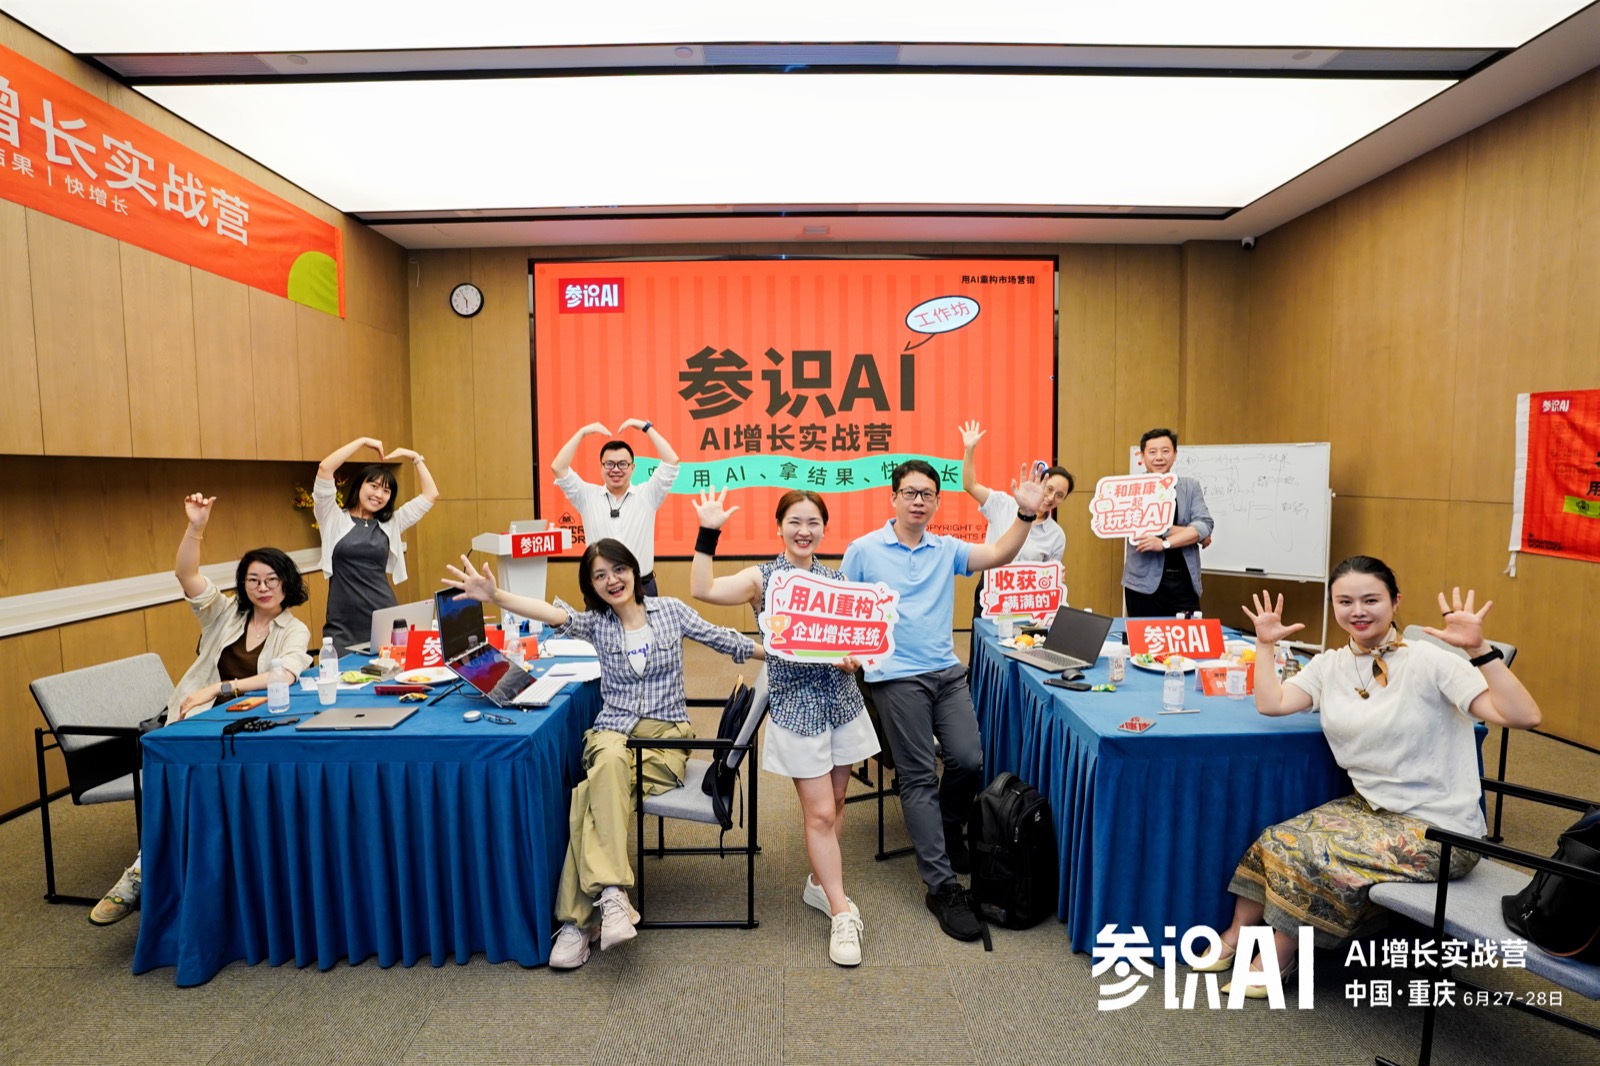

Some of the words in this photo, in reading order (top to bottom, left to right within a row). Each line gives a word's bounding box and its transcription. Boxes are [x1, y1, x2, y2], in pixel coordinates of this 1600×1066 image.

[0, 75, 249, 246] 长实战营
[0, 148, 35, 178] 果
[64, 174, 128, 216] 快增长
[961, 275, 1035, 285] 用AI重构市场营销
[565, 284, 618, 308] 参识AI
[914, 301, 970, 328] 工作坊
[677, 345, 916, 420] 参识AI
[700, 421, 893, 454] AI增长实战营
[1114, 481, 1157, 497] 和康康
[1119, 497, 1143, 507] 一起
[1104, 501, 1172, 531] 玩转AI
[520, 535, 555, 554] 参识AI
[995, 570, 1036, 591] 收获
[787, 585, 874, 620] 用AI重构
[790, 621, 880, 648] 企业增长系统
[1144, 626, 1210, 652] 参识AI
